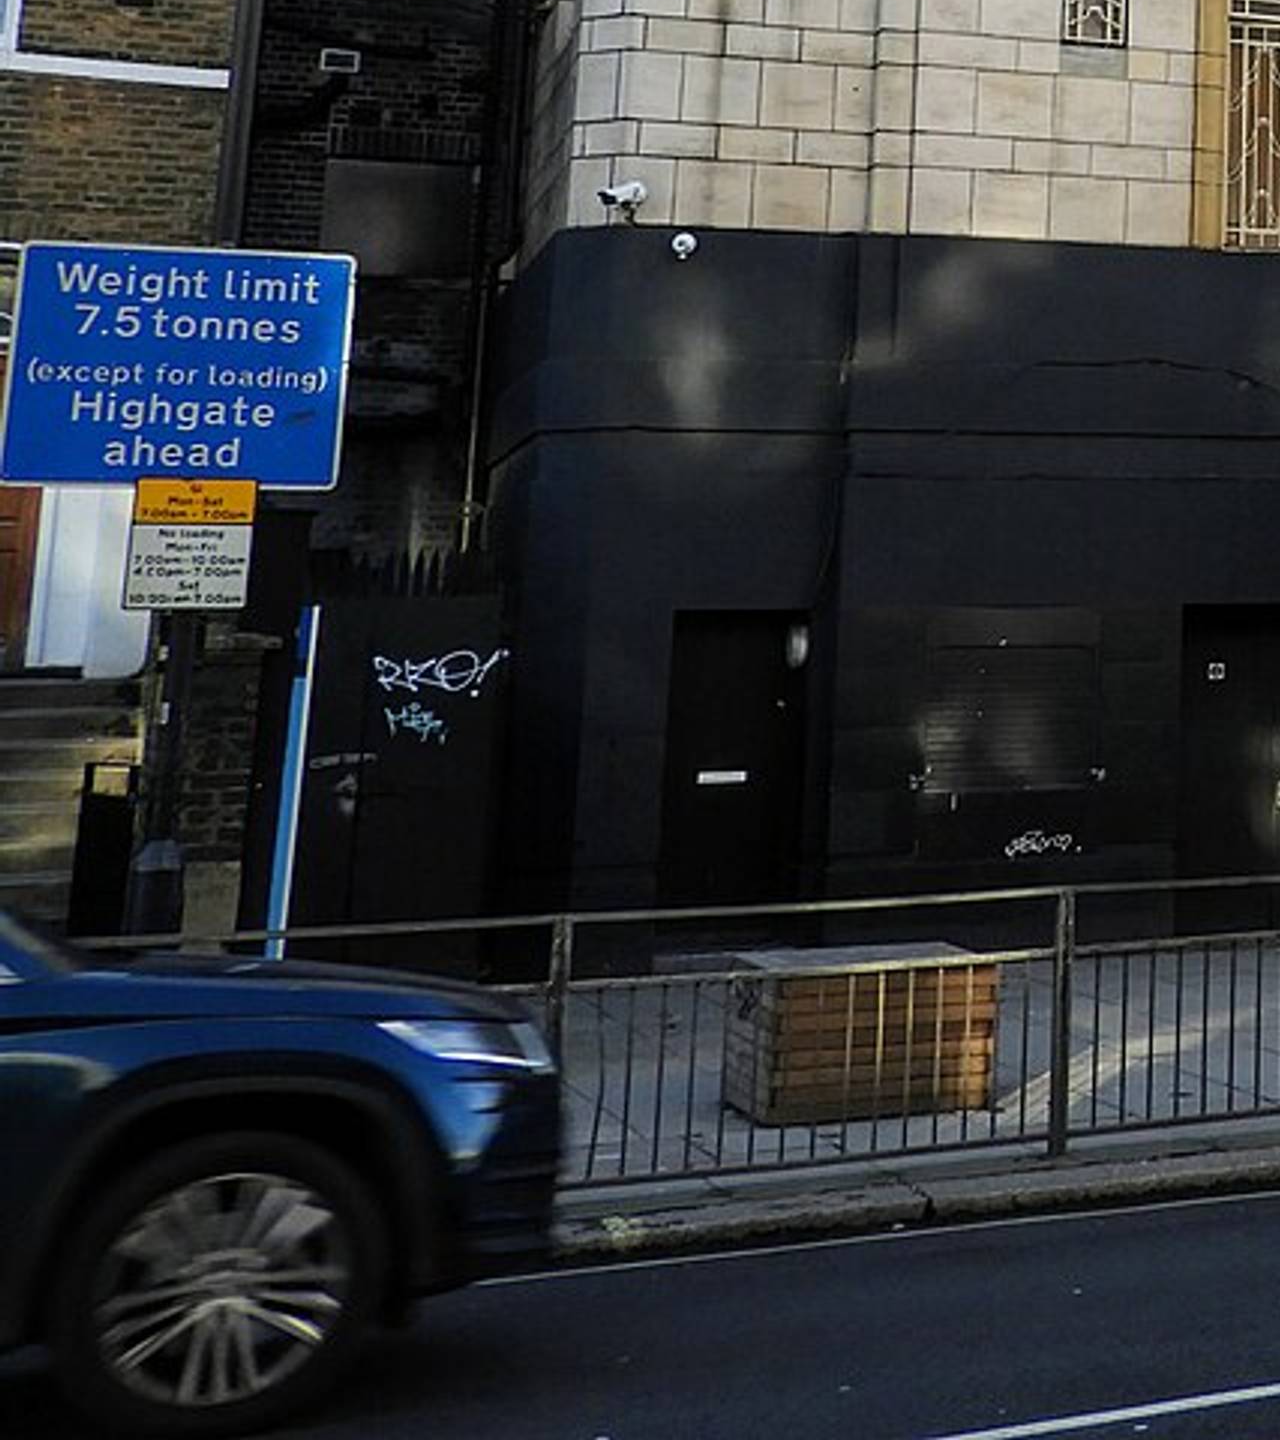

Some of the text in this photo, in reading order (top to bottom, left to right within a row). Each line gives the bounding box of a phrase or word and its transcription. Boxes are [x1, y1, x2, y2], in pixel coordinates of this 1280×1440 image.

[57, 261, 320, 305] Weight limit
[74, 303, 301, 343] 7.5 tonnes
[27, 357, 328, 394] (except for loading)
[70, 390, 275, 431] Highgate
[103, 436, 241, 467] ahead
